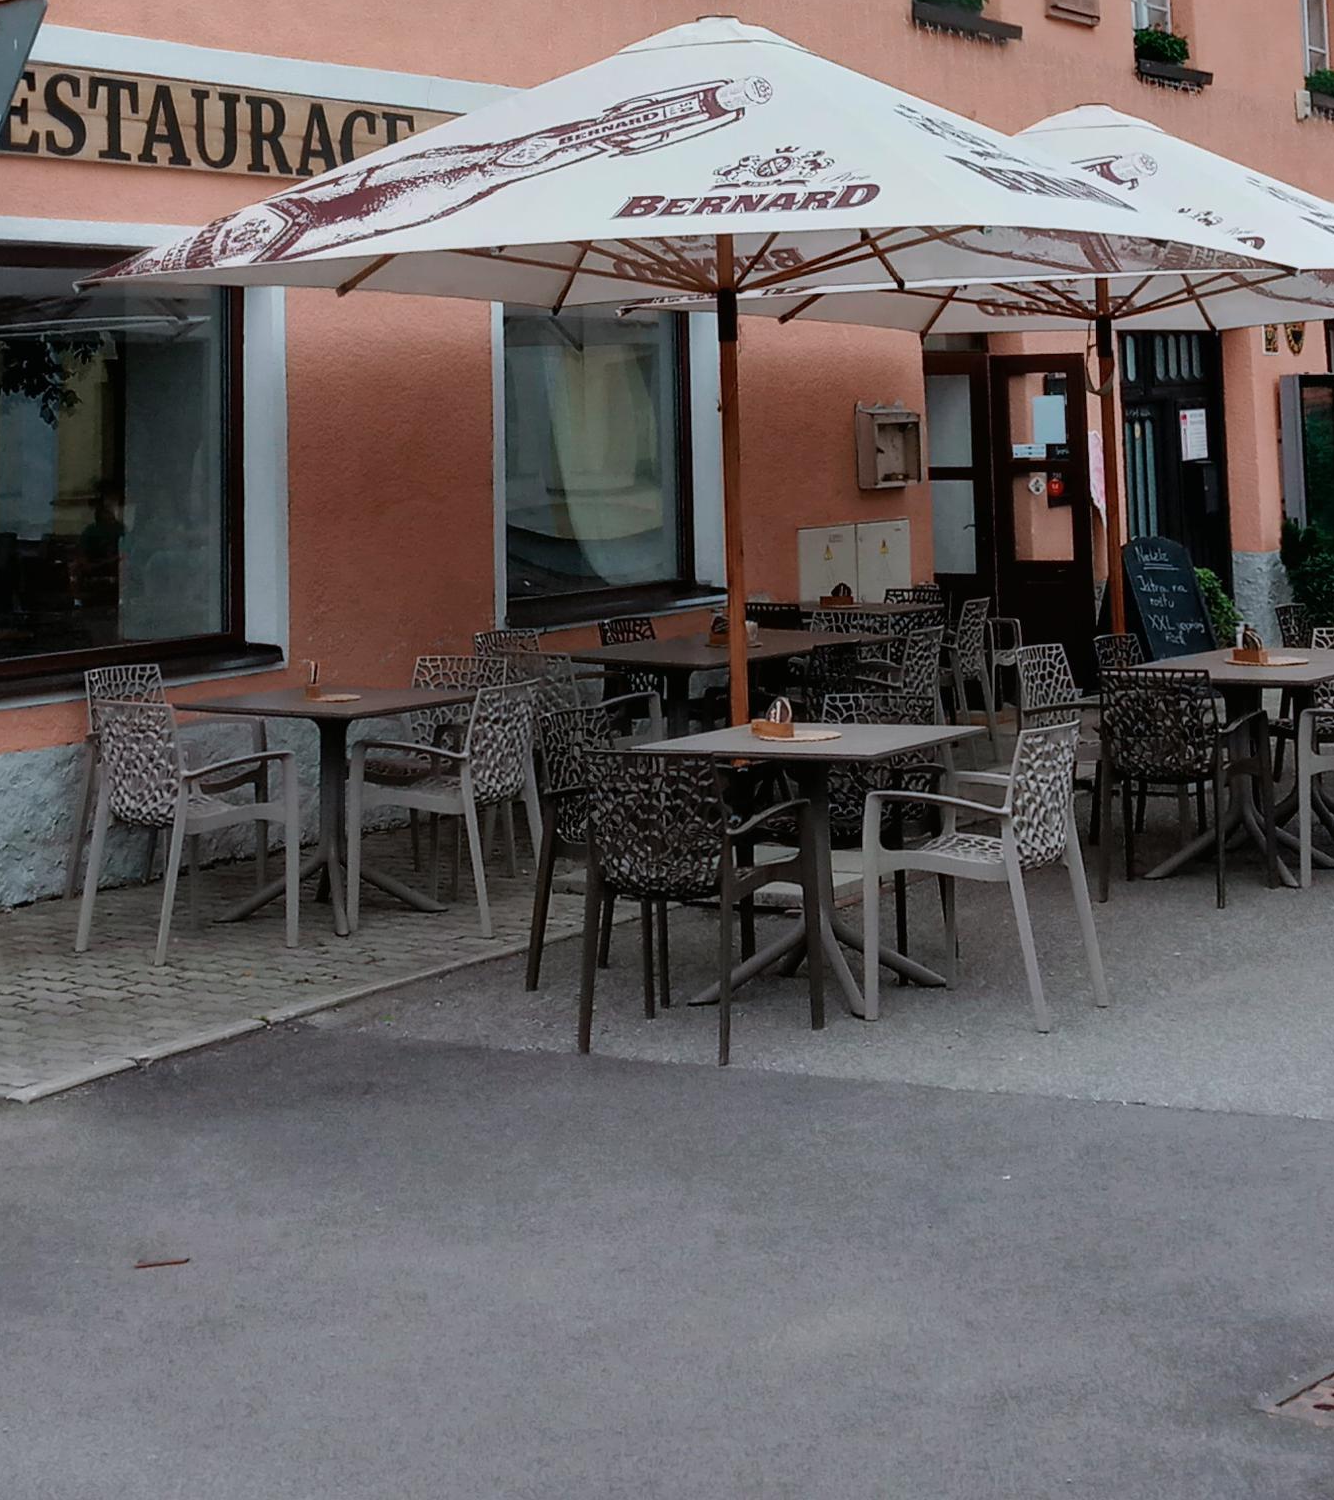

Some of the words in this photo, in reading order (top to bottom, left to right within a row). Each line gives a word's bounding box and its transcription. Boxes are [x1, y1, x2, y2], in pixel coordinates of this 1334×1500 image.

[558, 111, 660, 146] BERNARD
[612, 182, 881, 220] BERNARD
[1147, 614, 1176, 632] XXL
